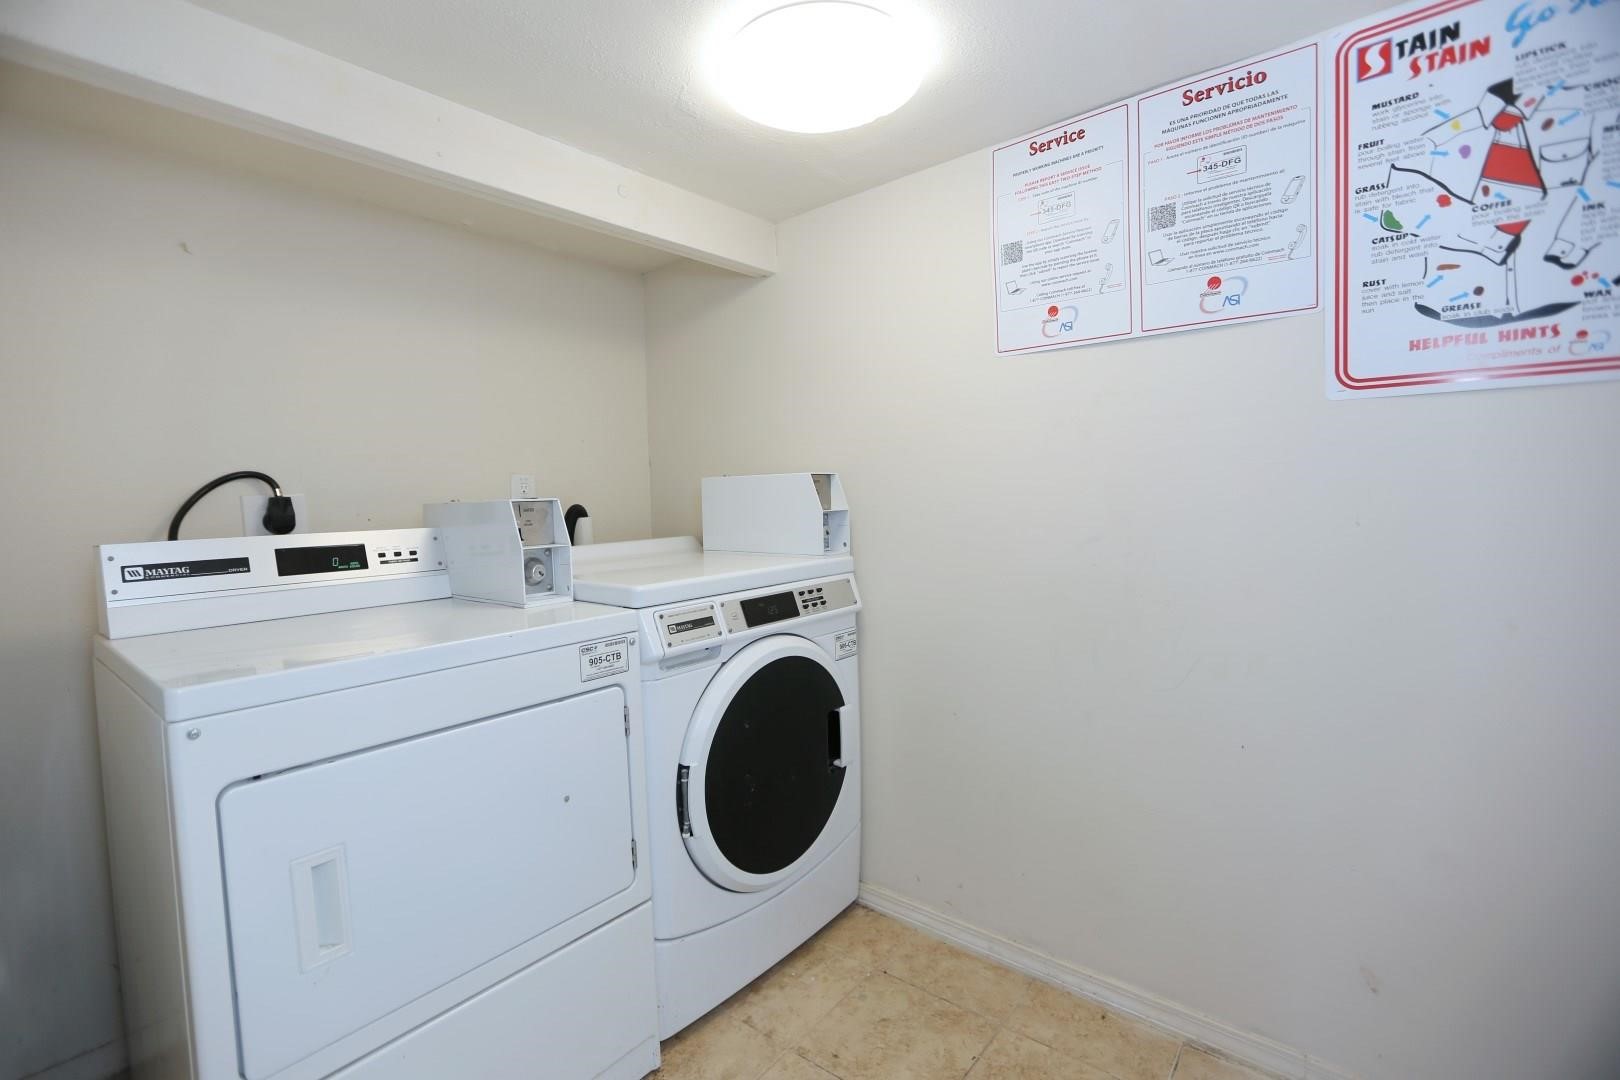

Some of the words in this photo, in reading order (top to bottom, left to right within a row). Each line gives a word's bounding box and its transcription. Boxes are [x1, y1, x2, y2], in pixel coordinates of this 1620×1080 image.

[1396, 20, 1460, 60] TAIN
[1408, 35, 1491, 80] STAIN
[1515, 41, 1566, 62] LIPSTICK
[1182, 70, 1268, 107] Servicio
[1190, 106, 1221, 119] PRIORIDAD
[1231, 99, 1243, 107] QUE
[1245, 93, 1265, 103] TODAS
[1267, 89, 1278, 97] LAS
[1371, 92, 1420, 111] MUSTARD
[1192, 111, 1225, 126] FUNCIONEN
[1227, 93, 1287, 115] APROPRIADAMENTE
[1181, 131, 1201, 141] INFORME
[1212, 119, 1242, 132] PROBLEMAS
[1253, 104, 1297, 120] MANTENIMIENTO
[1266, 114, 1283, 123] PASOS
[1371, 121, 1398, 132] rubbing
[1029, 128, 1085, 156] Service
[1358, 138, 1385, 151] FRUIT
[1377, 142, 1401, 153] boiling
[1203, 155, 1241, 172] 345-DFG
[1358, 152, 1385, 164] through
[1354, 194, 1367, 202] rub
[1369, 186, 1404, 199] detergent
[1355, 182, 1386, 195] GRASS
[1471, 200, 1513, 213] COFFEE
[1371, 232, 1409, 245] CATSUP
[1385, 245, 1420, 257] detergent
[1409, 251, 1429, 259] wash
[1362, 278, 1387, 288] RUST
[1401, 280, 1425, 288] lemon
[1361, 294, 1379, 302] juice
[1380, 298, 1400, 307] place
[1441, 302, 1481, 313] GREASE
[1408, 331, 1488, 352] HELPFUL
[1498, 323, 1561, 343] HINTS
[145, 566, 190, 577] MAYTAG
[589, 652, 622, 667] 905-CTB
